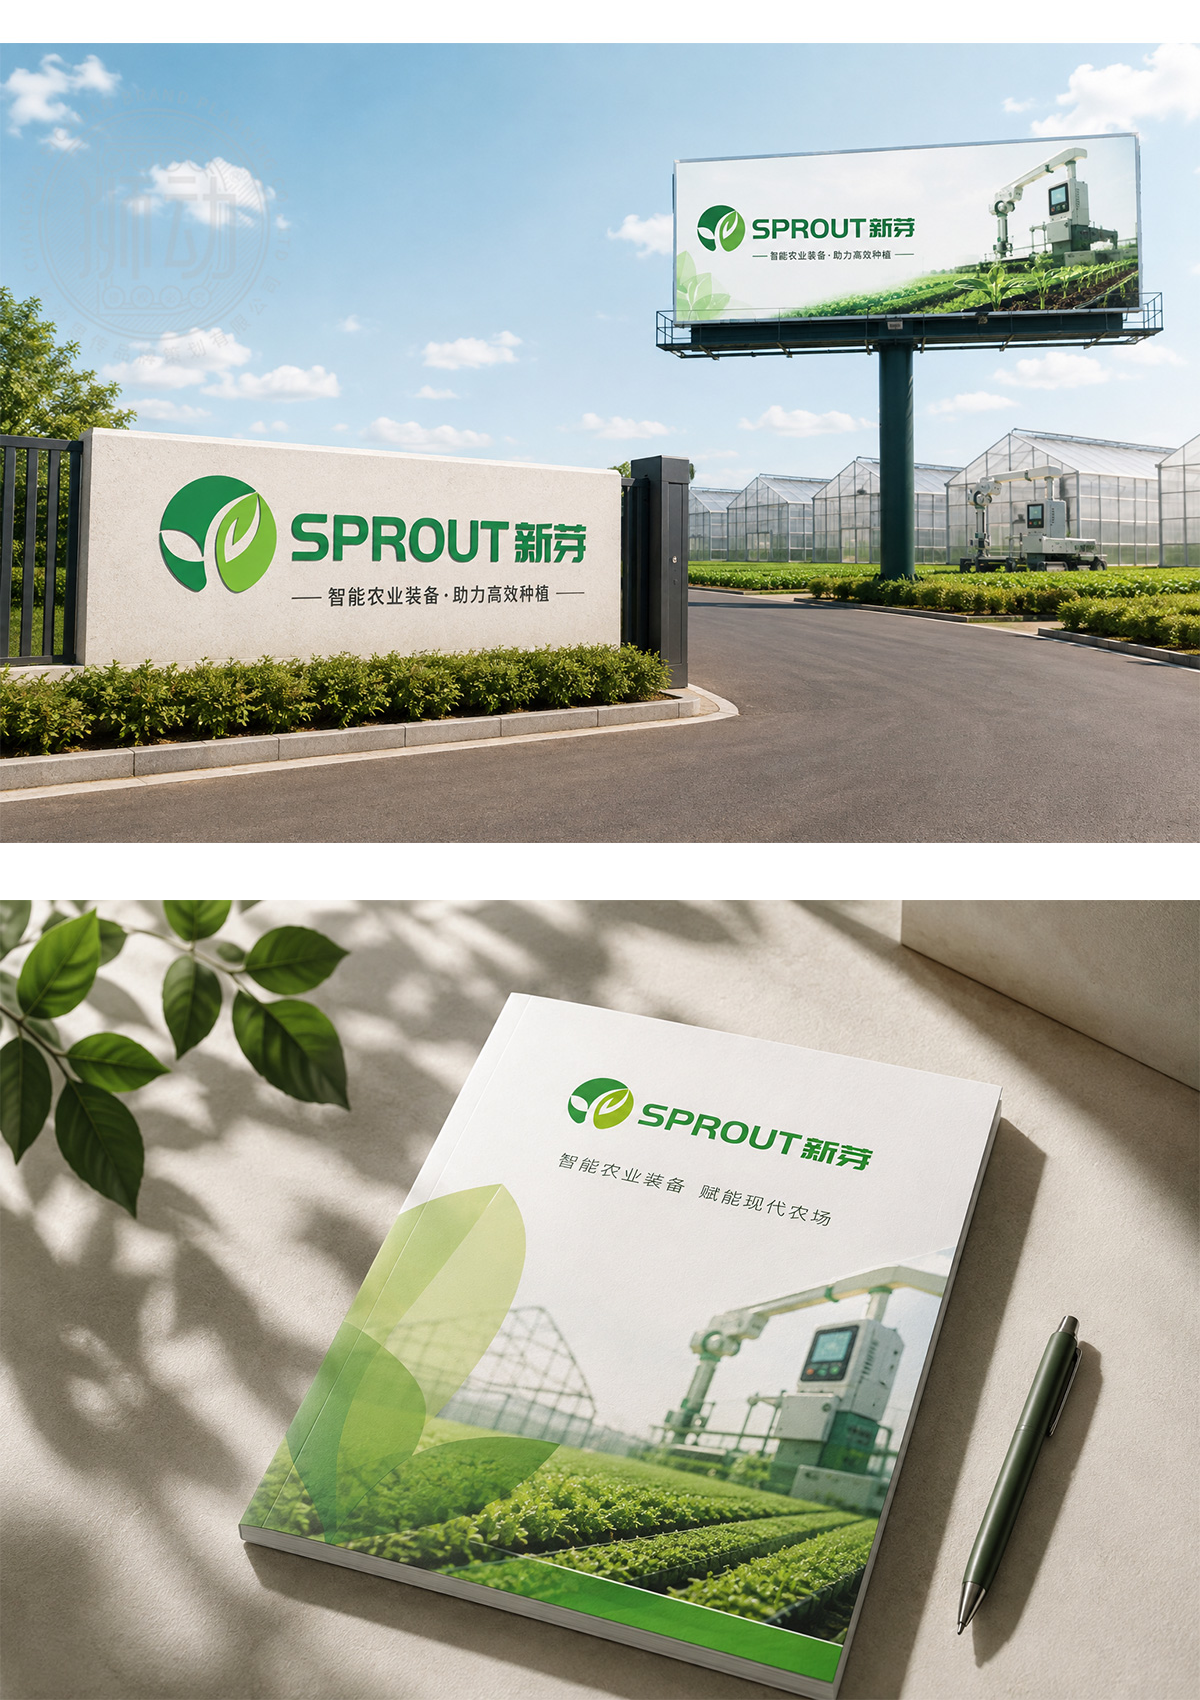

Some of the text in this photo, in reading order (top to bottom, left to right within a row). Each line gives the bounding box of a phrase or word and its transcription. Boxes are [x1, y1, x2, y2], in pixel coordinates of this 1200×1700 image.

[752, 217, 915, 240] SPROUT 新芽
[291, 513, 587, 563] SPROUT 新芽
[637, 1103, 874, 1171] SPROUT 新芽
[558, 1152, 832, 1227] 智能农业装备 赋能现代农场
